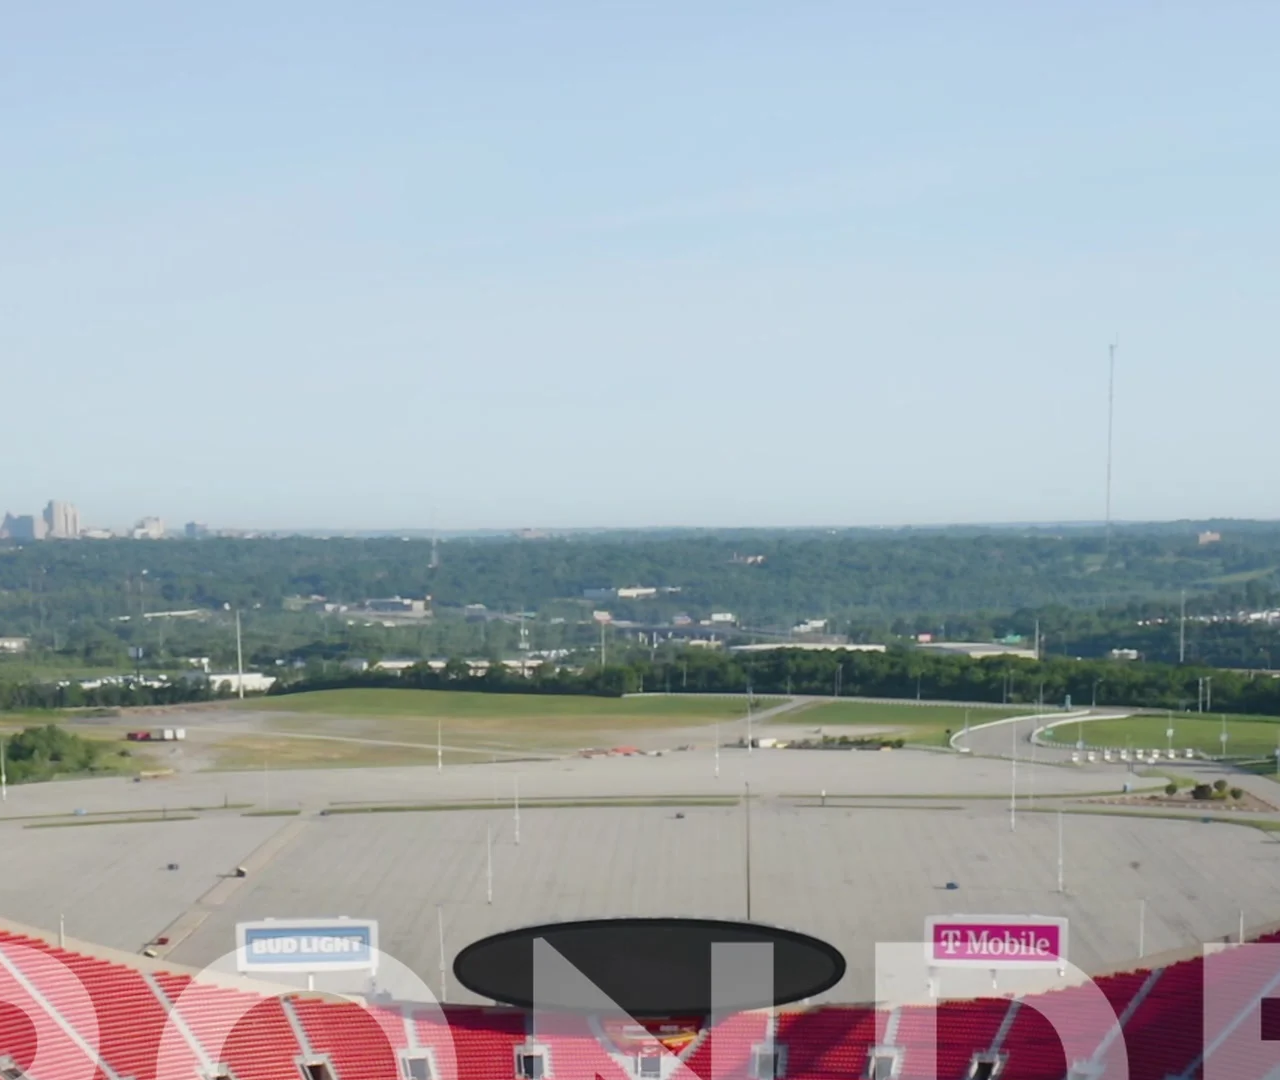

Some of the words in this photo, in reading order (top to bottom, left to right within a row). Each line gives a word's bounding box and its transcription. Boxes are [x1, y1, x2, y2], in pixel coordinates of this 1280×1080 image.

[252, 938, 297, 954] BUD
[300, 936, 363, 953] LIGHT
[965, 930, 1051, 956] Mobile
